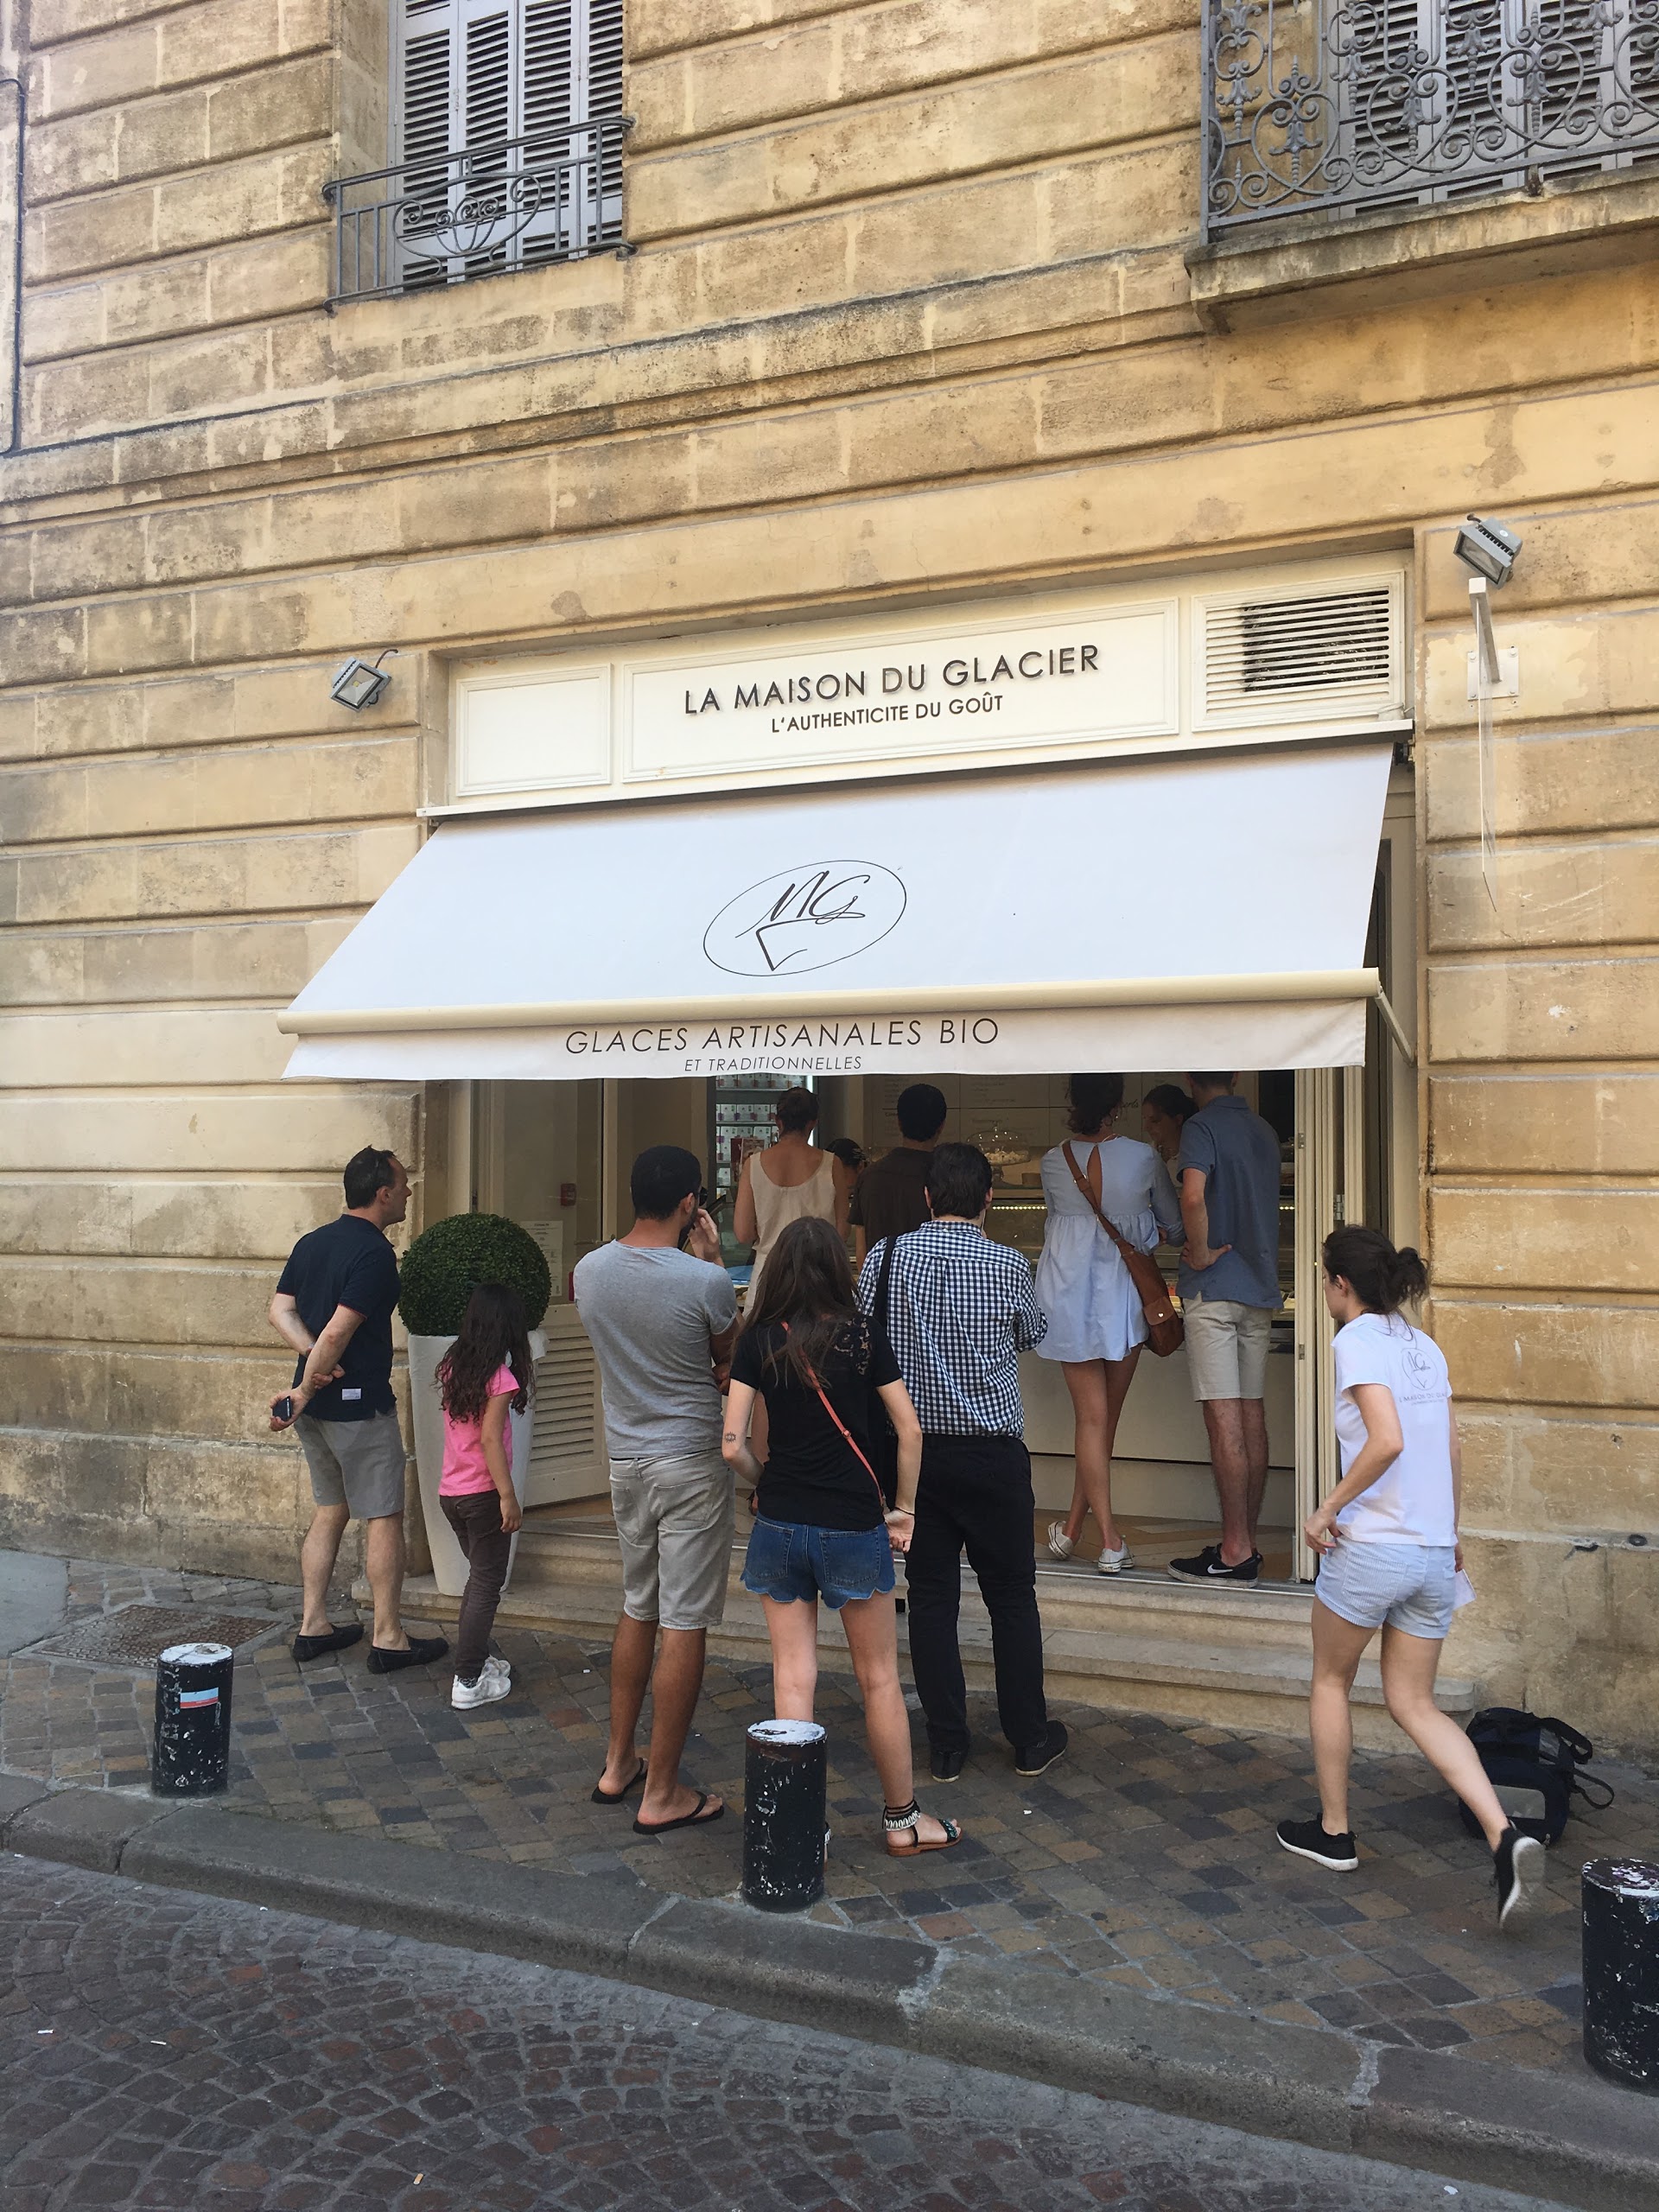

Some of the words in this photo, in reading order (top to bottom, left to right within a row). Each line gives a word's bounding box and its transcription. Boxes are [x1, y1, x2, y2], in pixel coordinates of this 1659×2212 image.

[684, 688, 721, 715] LA
[734, 668, 865, 709] MAISON
[882, 664, 925, 694] DU
[943, 644, 1099, 687] GLACIER
[916, 702, 941, 719] DU
[949, 691, 1003, 715] GOÛT
[565, 1027, 688, 1054] GLACES
[702, 1020, 921, 1049] ARTISANALES
[939, 1017, 999, 1045] BIO
[684, 1058, 702, 1071] ET
[709, 1056, 861, 1071] TRADITIONNELLES
